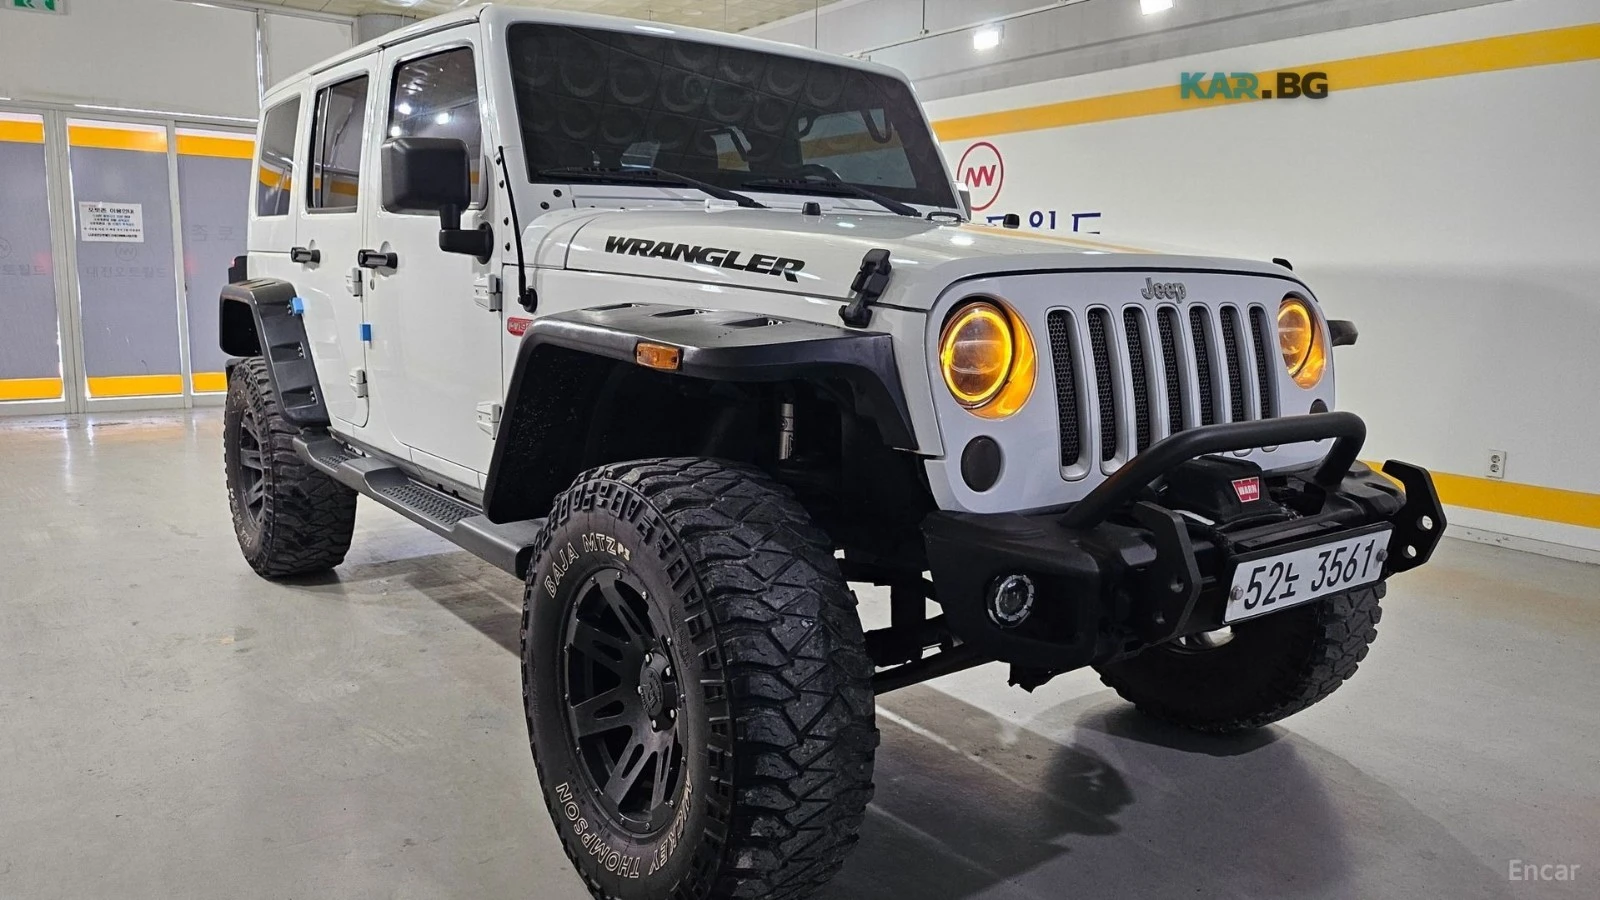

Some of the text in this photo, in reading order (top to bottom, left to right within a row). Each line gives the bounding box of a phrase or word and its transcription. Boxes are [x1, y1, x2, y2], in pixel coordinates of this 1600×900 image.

[605, 235, 806, 283] WRANGLER
[1140, 277, 1187, 304] Jeep
[1237, 484, 1257, 496] WARN
[544, 542, 580, 599] BAJA
[1244, 539, 1376, 610] 52노 3561
[555, 768, 693, 879] MICKEY THOMPSON
